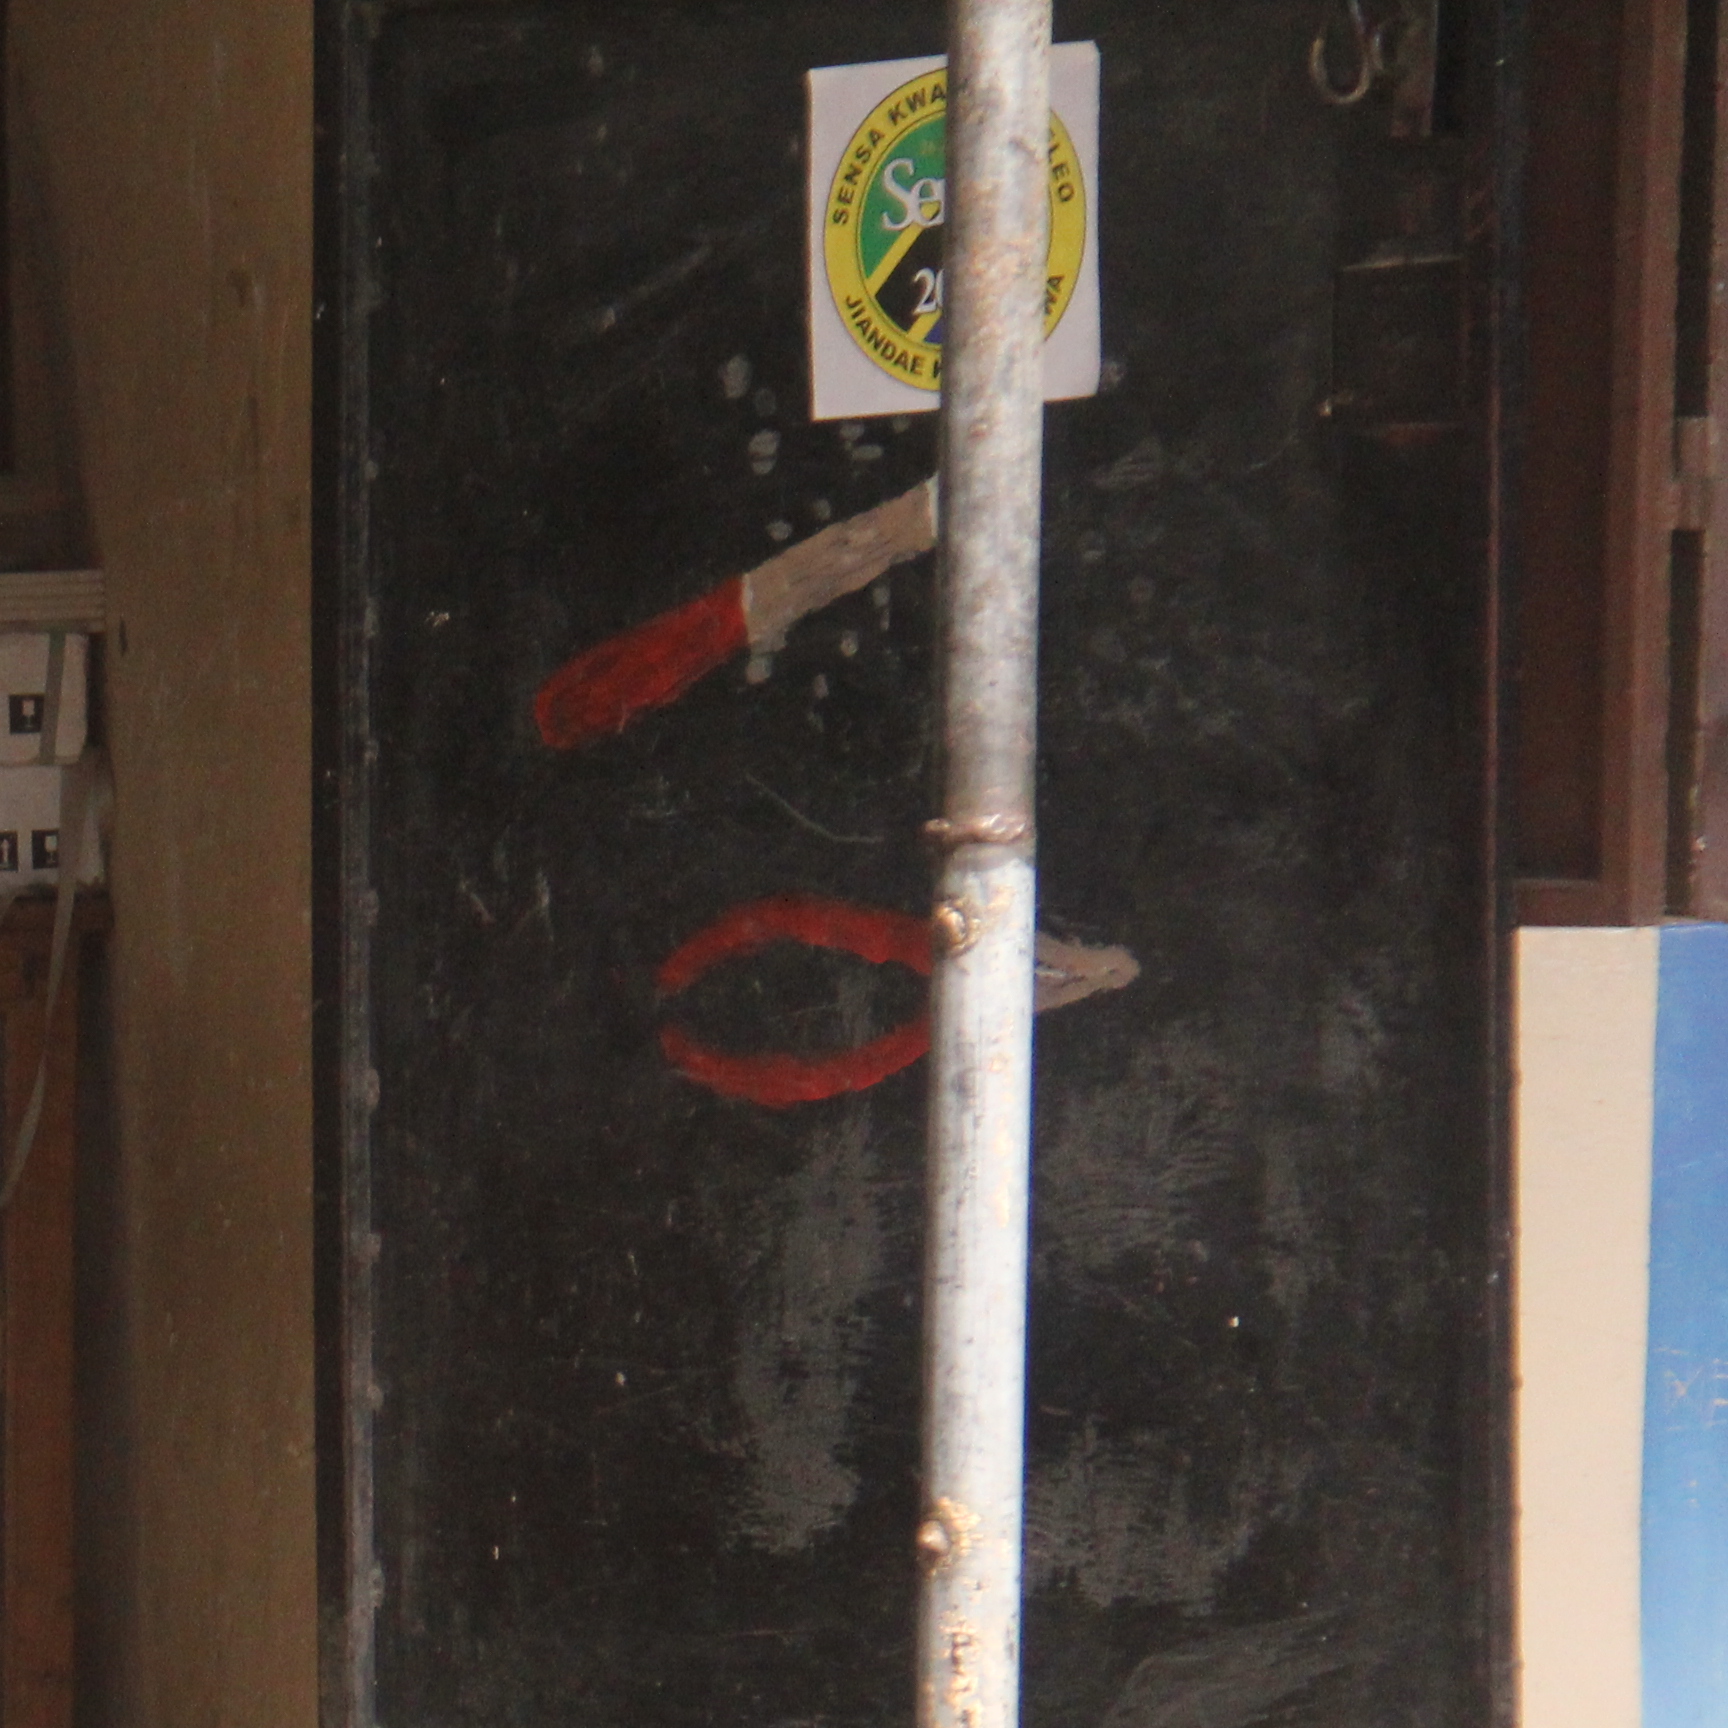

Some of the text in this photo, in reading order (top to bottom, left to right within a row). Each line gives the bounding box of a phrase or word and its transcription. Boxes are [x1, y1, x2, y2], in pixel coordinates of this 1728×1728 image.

[832, 129, 885, 226] SENSA
[1047, 128, 1075, 203] LEO
[845, 295, 926, 376] JIANDAE
